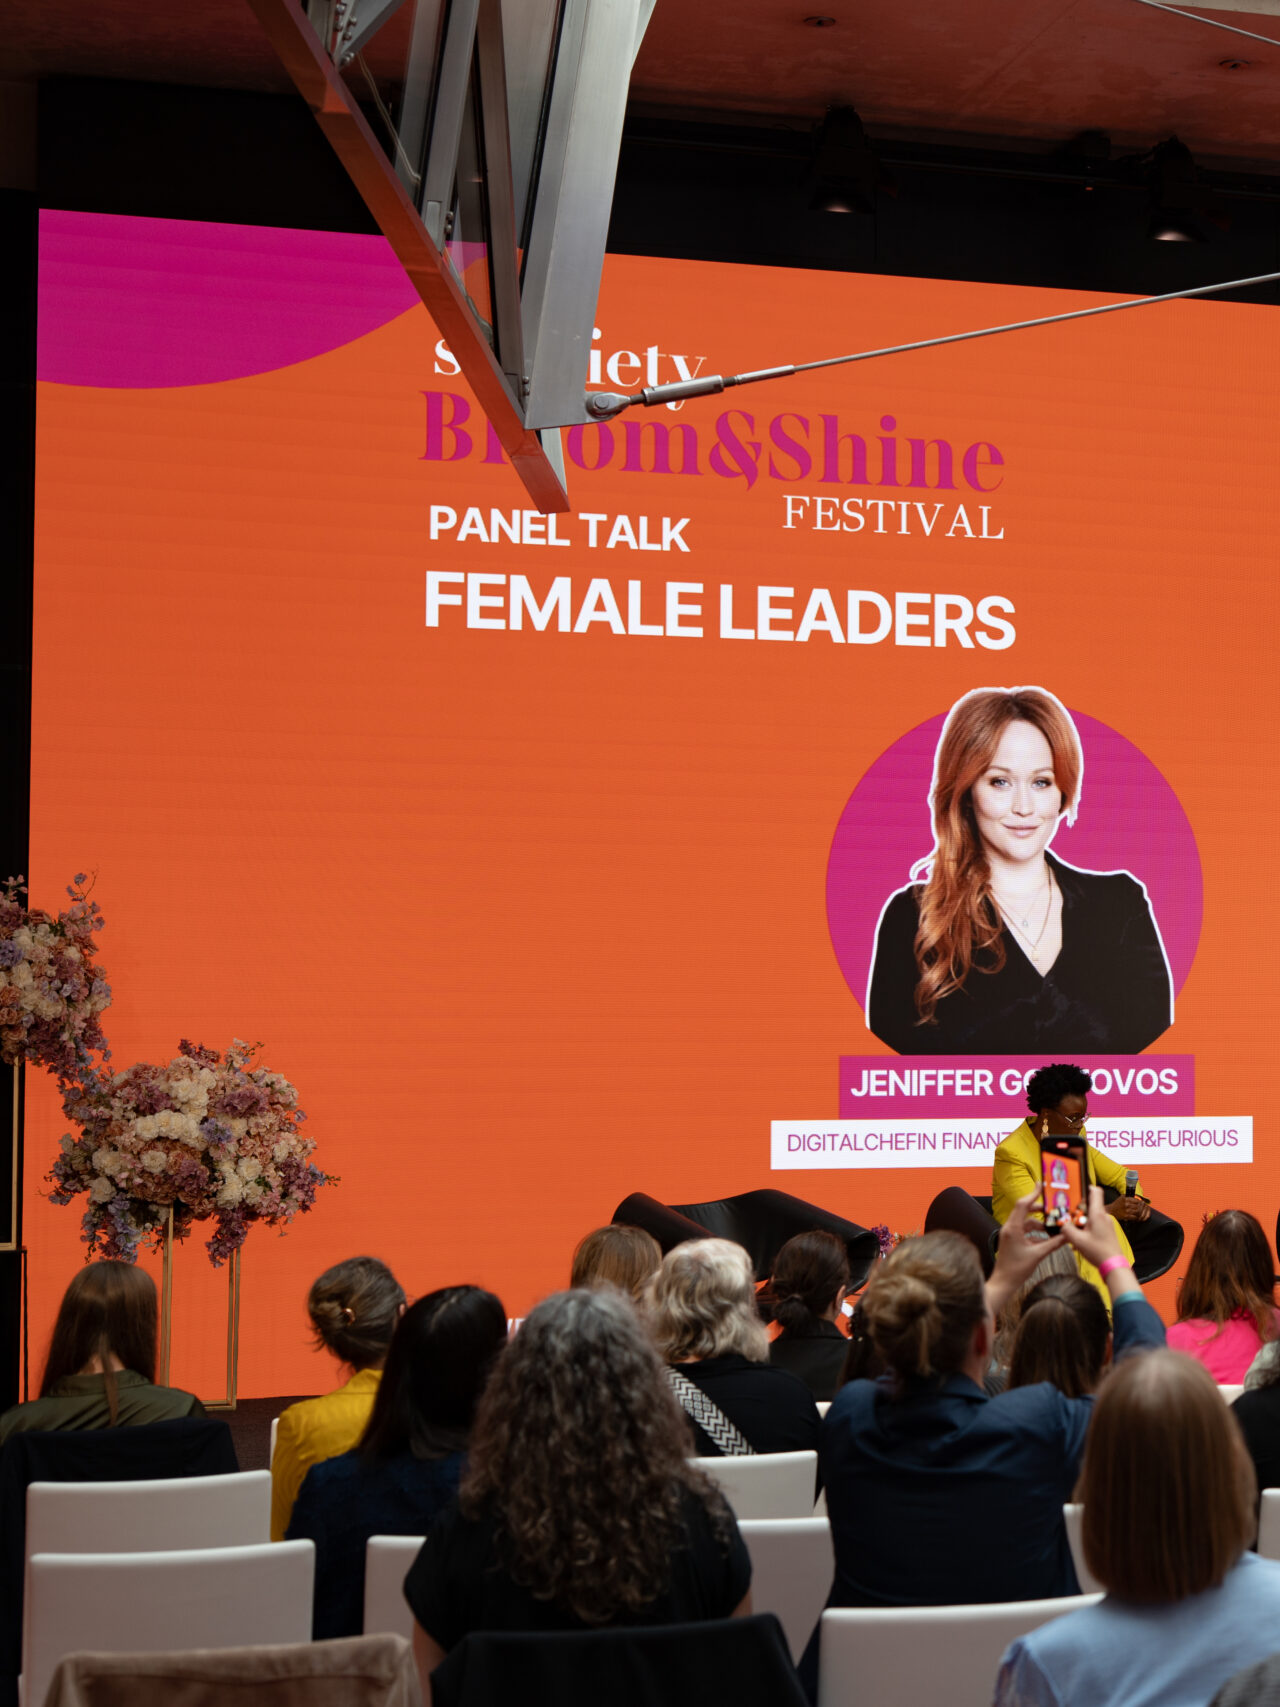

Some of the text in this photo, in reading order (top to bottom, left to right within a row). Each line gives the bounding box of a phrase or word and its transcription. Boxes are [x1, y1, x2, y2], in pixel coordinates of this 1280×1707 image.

[429, 504, 692, 553] PANEL TALK
[782, 494, 1004, 540] FESTIVAL
[425, 570, 1017, 651] FEMALE LEADERS
[850, 1069, 994, 1097] JENIFFER
[787, 1132, 937, 1153] DIGITALCHEFIN
